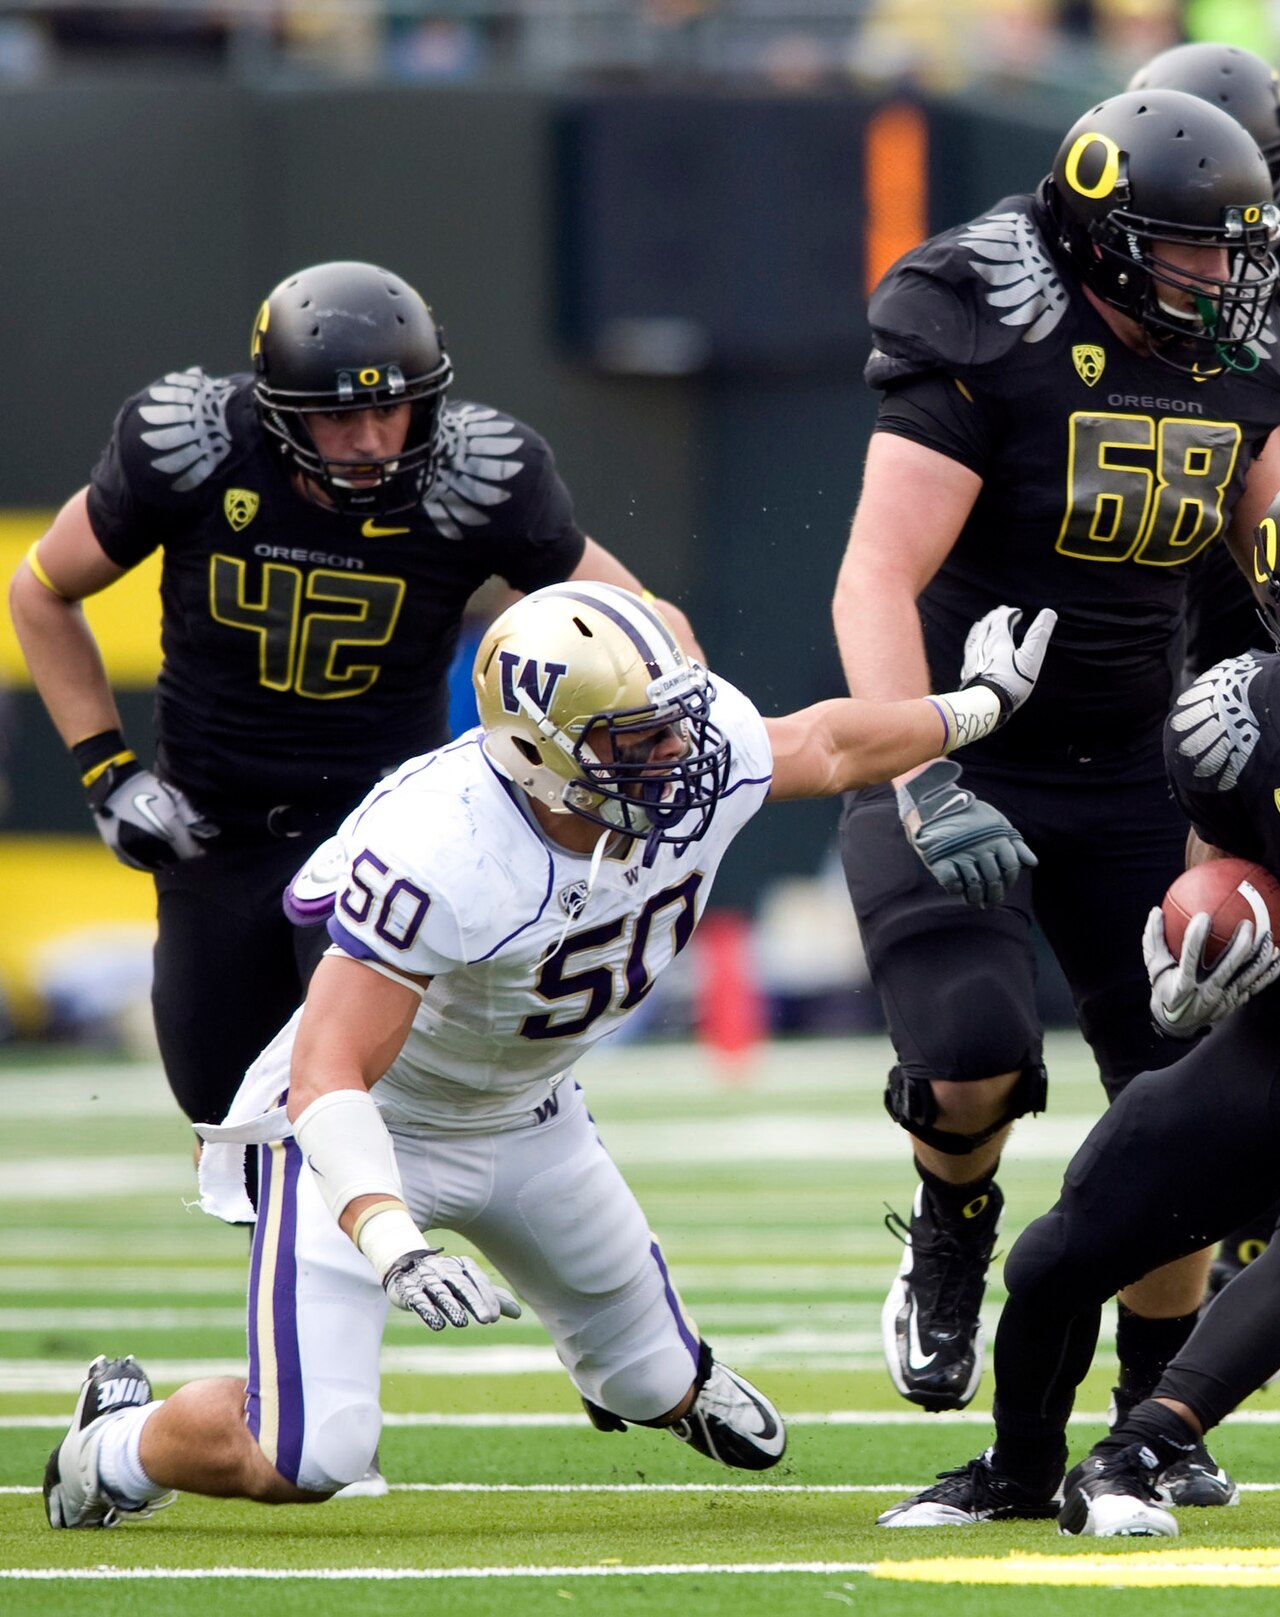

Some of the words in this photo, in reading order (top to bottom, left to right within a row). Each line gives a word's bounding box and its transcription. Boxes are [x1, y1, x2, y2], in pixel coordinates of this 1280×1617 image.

[1065, 132, 1119, 199] O
[1243, 207, 1260, 224] O
[359, 368, 380, 386] O
[1107, 393, 1203, 415] OREGON
[1055, 411, 1242, 567] 68
[254, 543, 364, 570] OREGON
[209, 554, 406, 700] 42
[498, 651, 567, 717] W
[623, 865, 640, 887] W
[339, 847, 432, 952] 50
[518, 869, 706, 1042] 50
[532, 1090, 559, 1125] W
[963, 1194, 989, 1219] O
